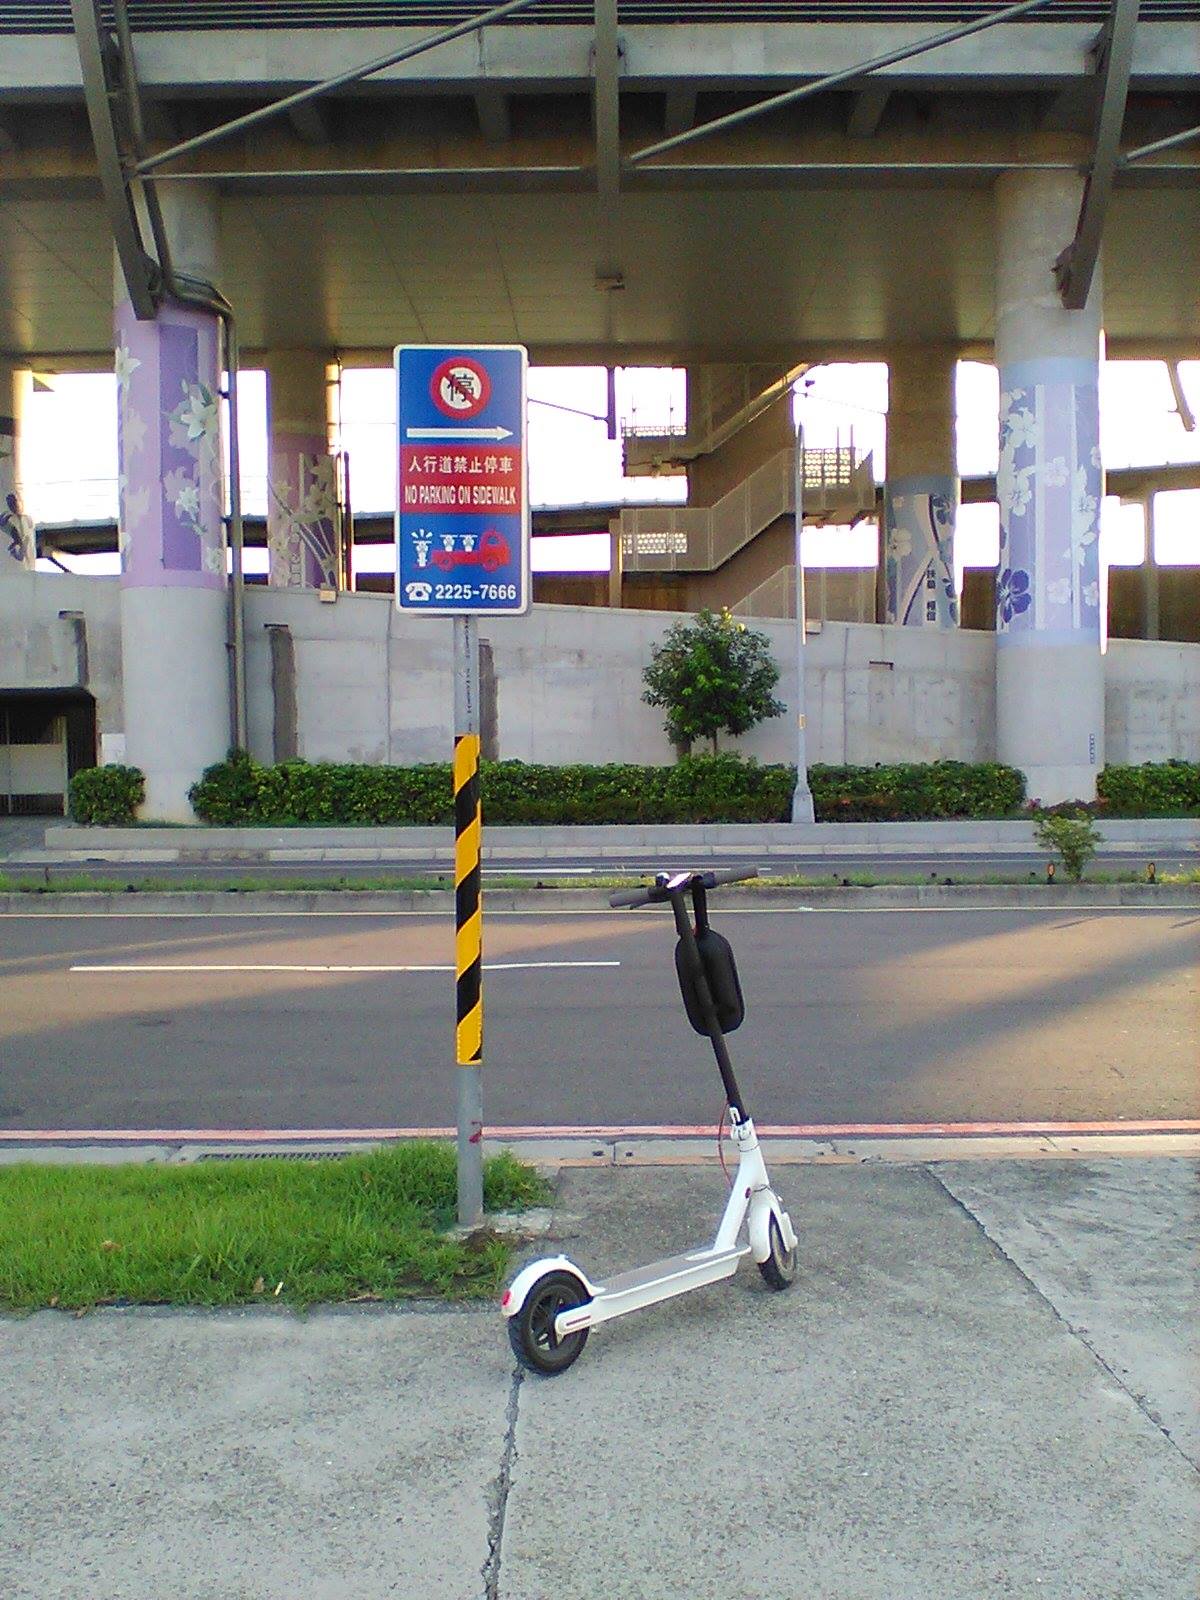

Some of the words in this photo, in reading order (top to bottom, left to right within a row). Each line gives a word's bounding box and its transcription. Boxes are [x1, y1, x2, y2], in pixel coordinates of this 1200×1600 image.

[447, 373, 474, 402] 停
[408, 455, 513, 474] 人行道禁止停車
[404, 485, 418, 504] NO
[420, 485, 456, 504] PARKING
[458, 485, 471, 504] ON
[473, 485, 516, 505] SIDEWALK
[435, 584, 517, 600] 2225-7666
